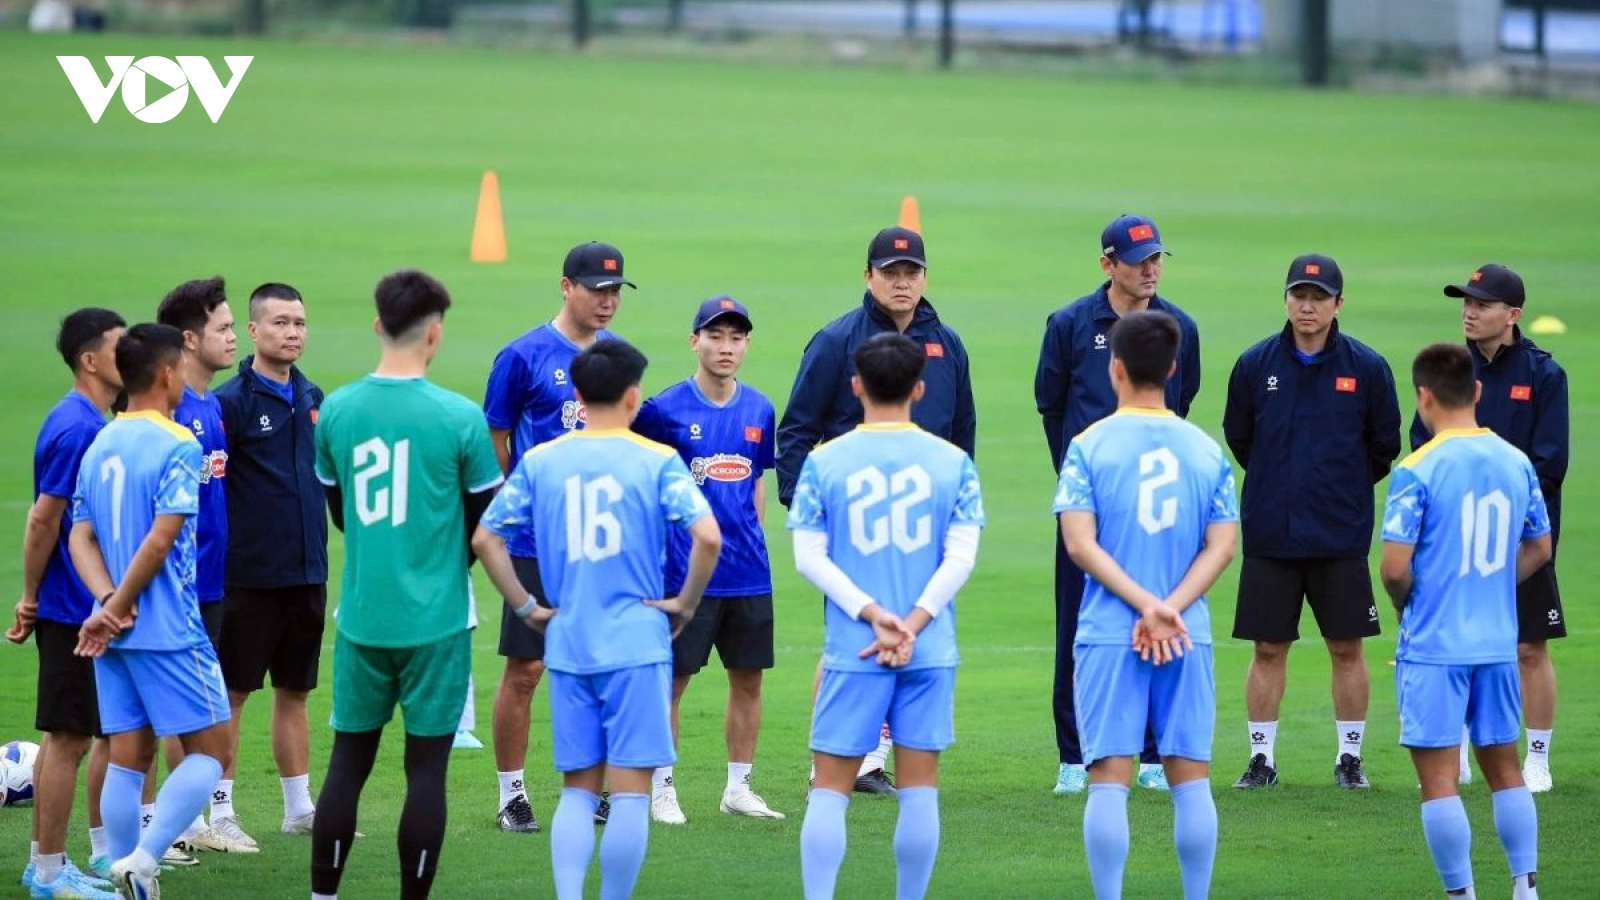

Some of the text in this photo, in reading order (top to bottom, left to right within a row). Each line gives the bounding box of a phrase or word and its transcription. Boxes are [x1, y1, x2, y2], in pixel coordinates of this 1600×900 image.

[102, 456, 125, 541] 7
[353, 437, 409, 527] 21
[566, 475, 624, 563] 16
[847, 464, 932, 556] 22
[1137, 447, 1179, 536] 2
[1459, 489, 1510, 578] 10
